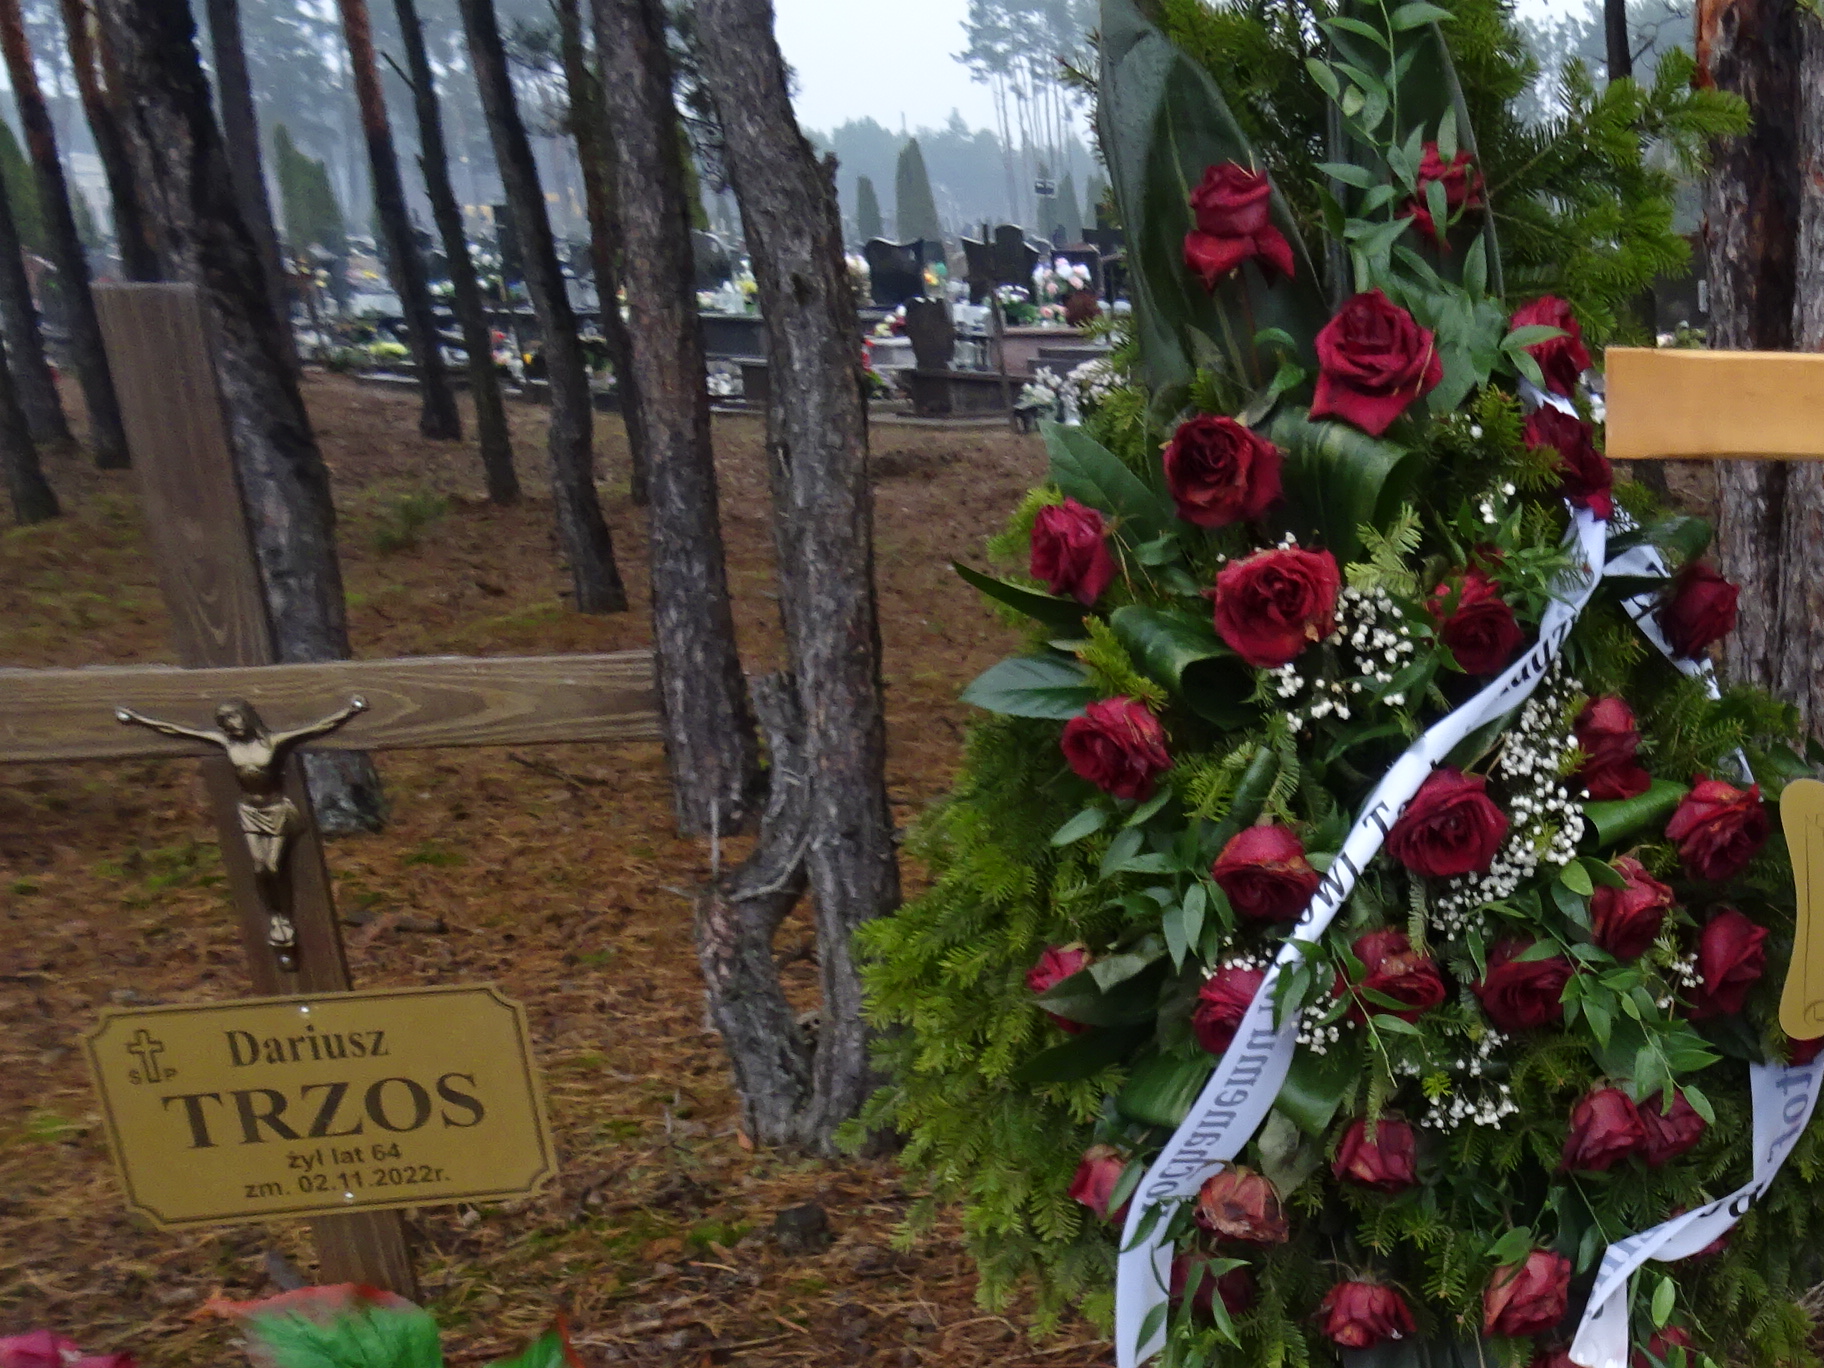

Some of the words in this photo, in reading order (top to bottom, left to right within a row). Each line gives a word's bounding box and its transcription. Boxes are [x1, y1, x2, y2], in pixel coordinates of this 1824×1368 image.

[225, 1024, 391, 1067] Dariusz
[161, 1071, 484, 1149] TRZOS
[331, 1146, 365, 1166] lat
[371, 1142, 402, 1162] 64
[245, 1180, 291, 1199] zm.
[299, 1164, 452, 1194] 02.11.2022r.
